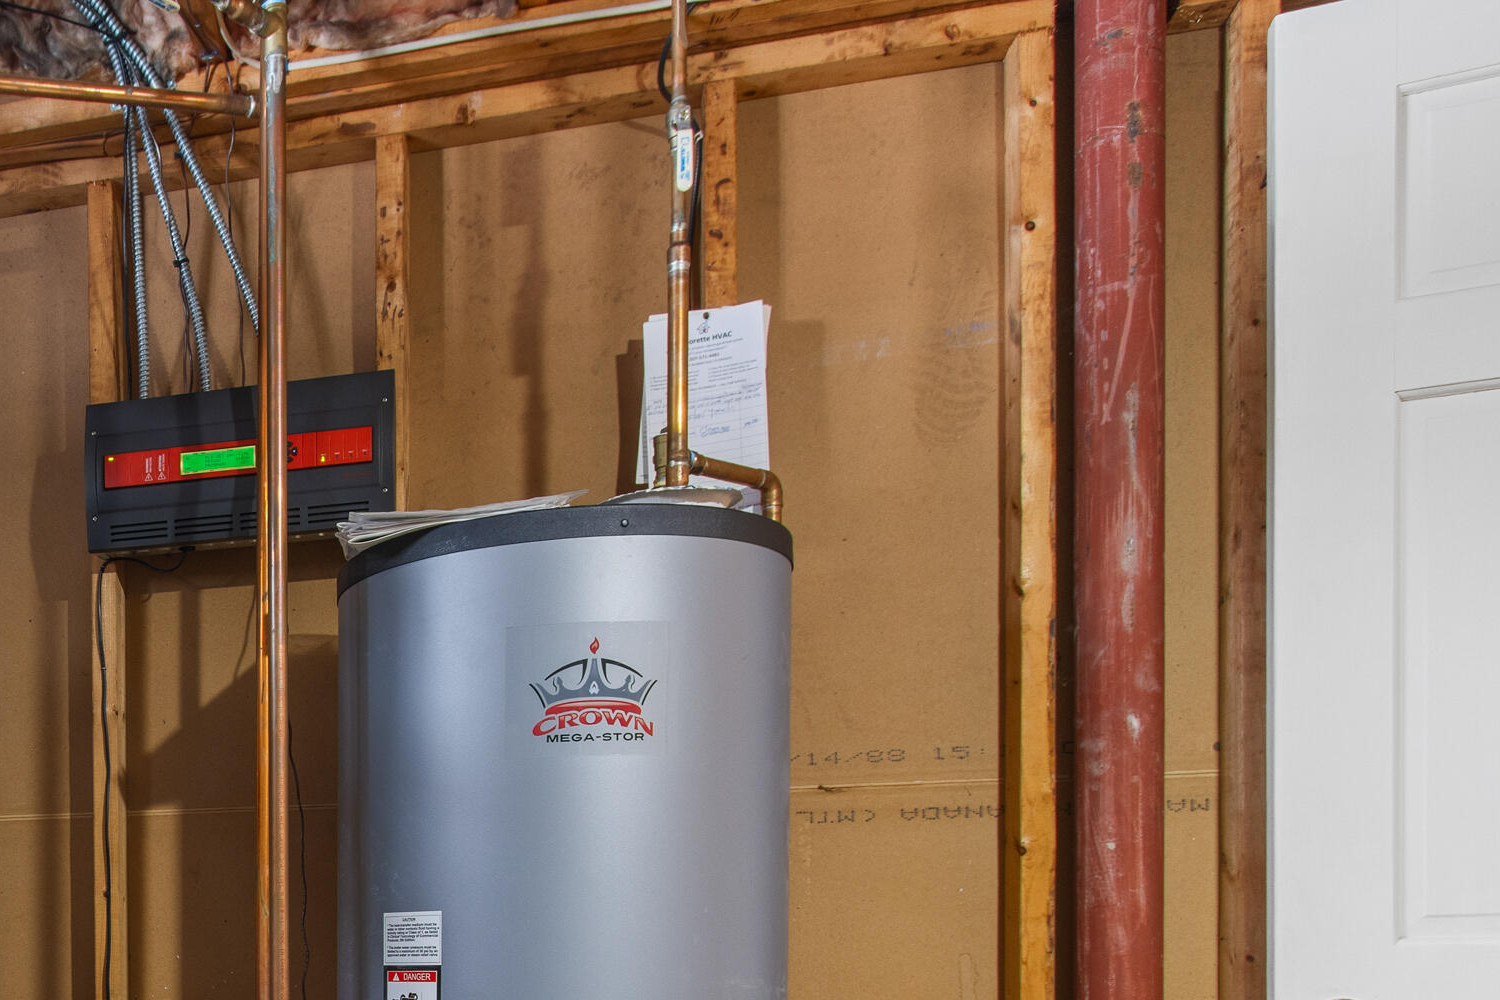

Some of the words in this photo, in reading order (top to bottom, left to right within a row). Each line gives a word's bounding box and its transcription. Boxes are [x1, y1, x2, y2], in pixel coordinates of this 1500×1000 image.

[712, 330, 733, 341] HVAC
[532, 710, 654, 737] CROWN
[546, 732, 645, 744] MEGA-STOR
[403, 972, 432, 981] DANGER
